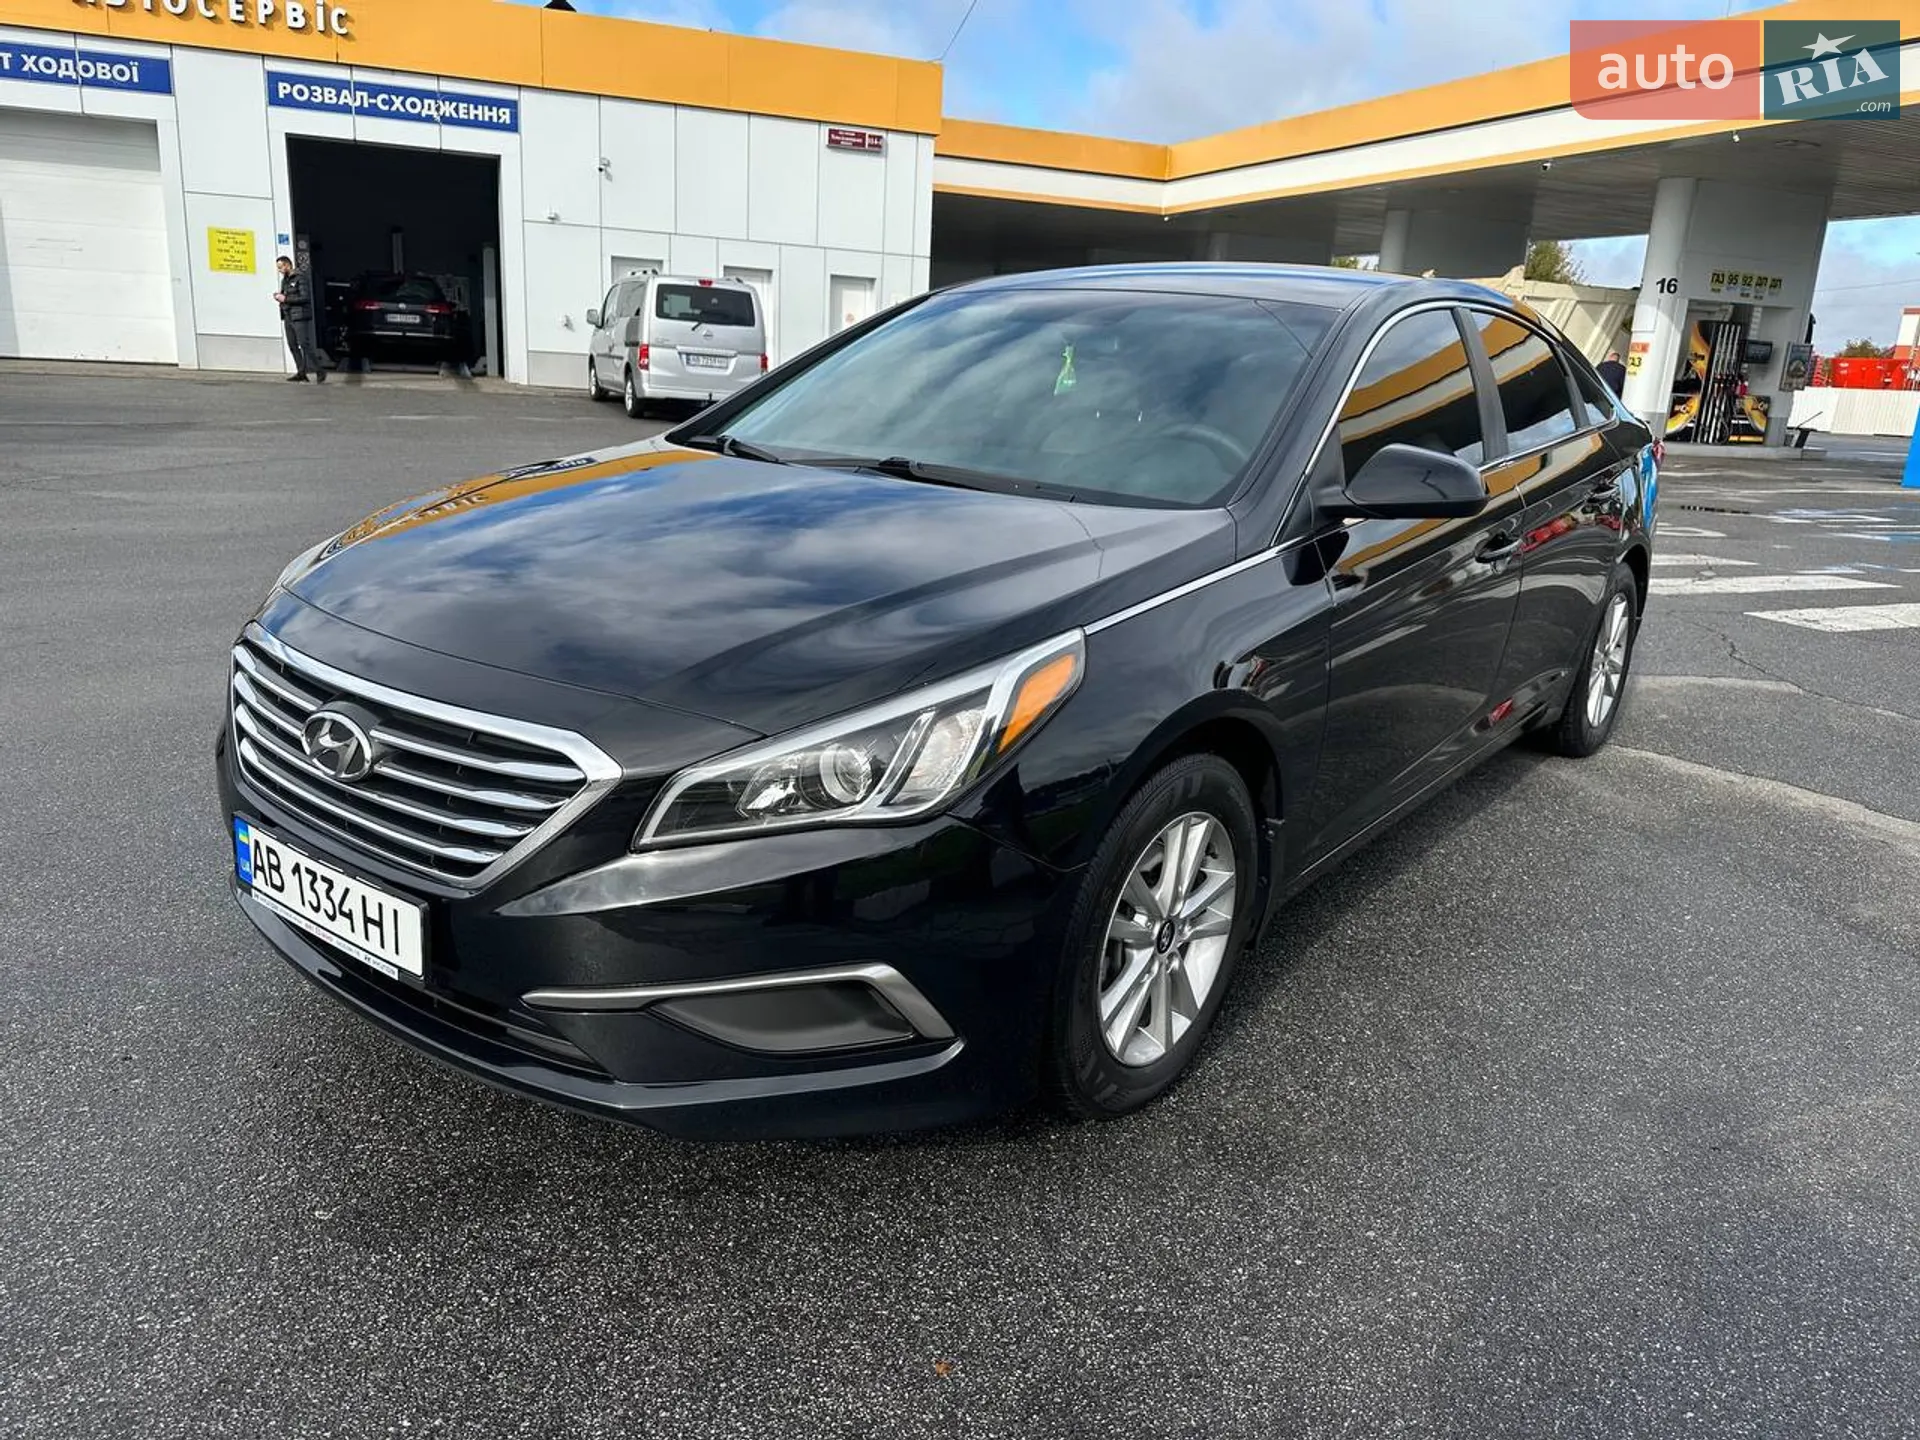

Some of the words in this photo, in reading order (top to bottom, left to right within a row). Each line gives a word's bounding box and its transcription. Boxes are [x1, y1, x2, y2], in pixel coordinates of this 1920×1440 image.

[20, 54, 140, 84] ХОДОВОЇ
[277, 81, 512, 124] РОЗВАЛ-СХОДЖЕННЯ
[1656, 277, 1678, 294] 16
[1727, 274, 1739, 286] 95
[1741, 276, 1753, 287] 92
[253, 838, 285, 893] AB
[291, 861, 356, 934] 1334
